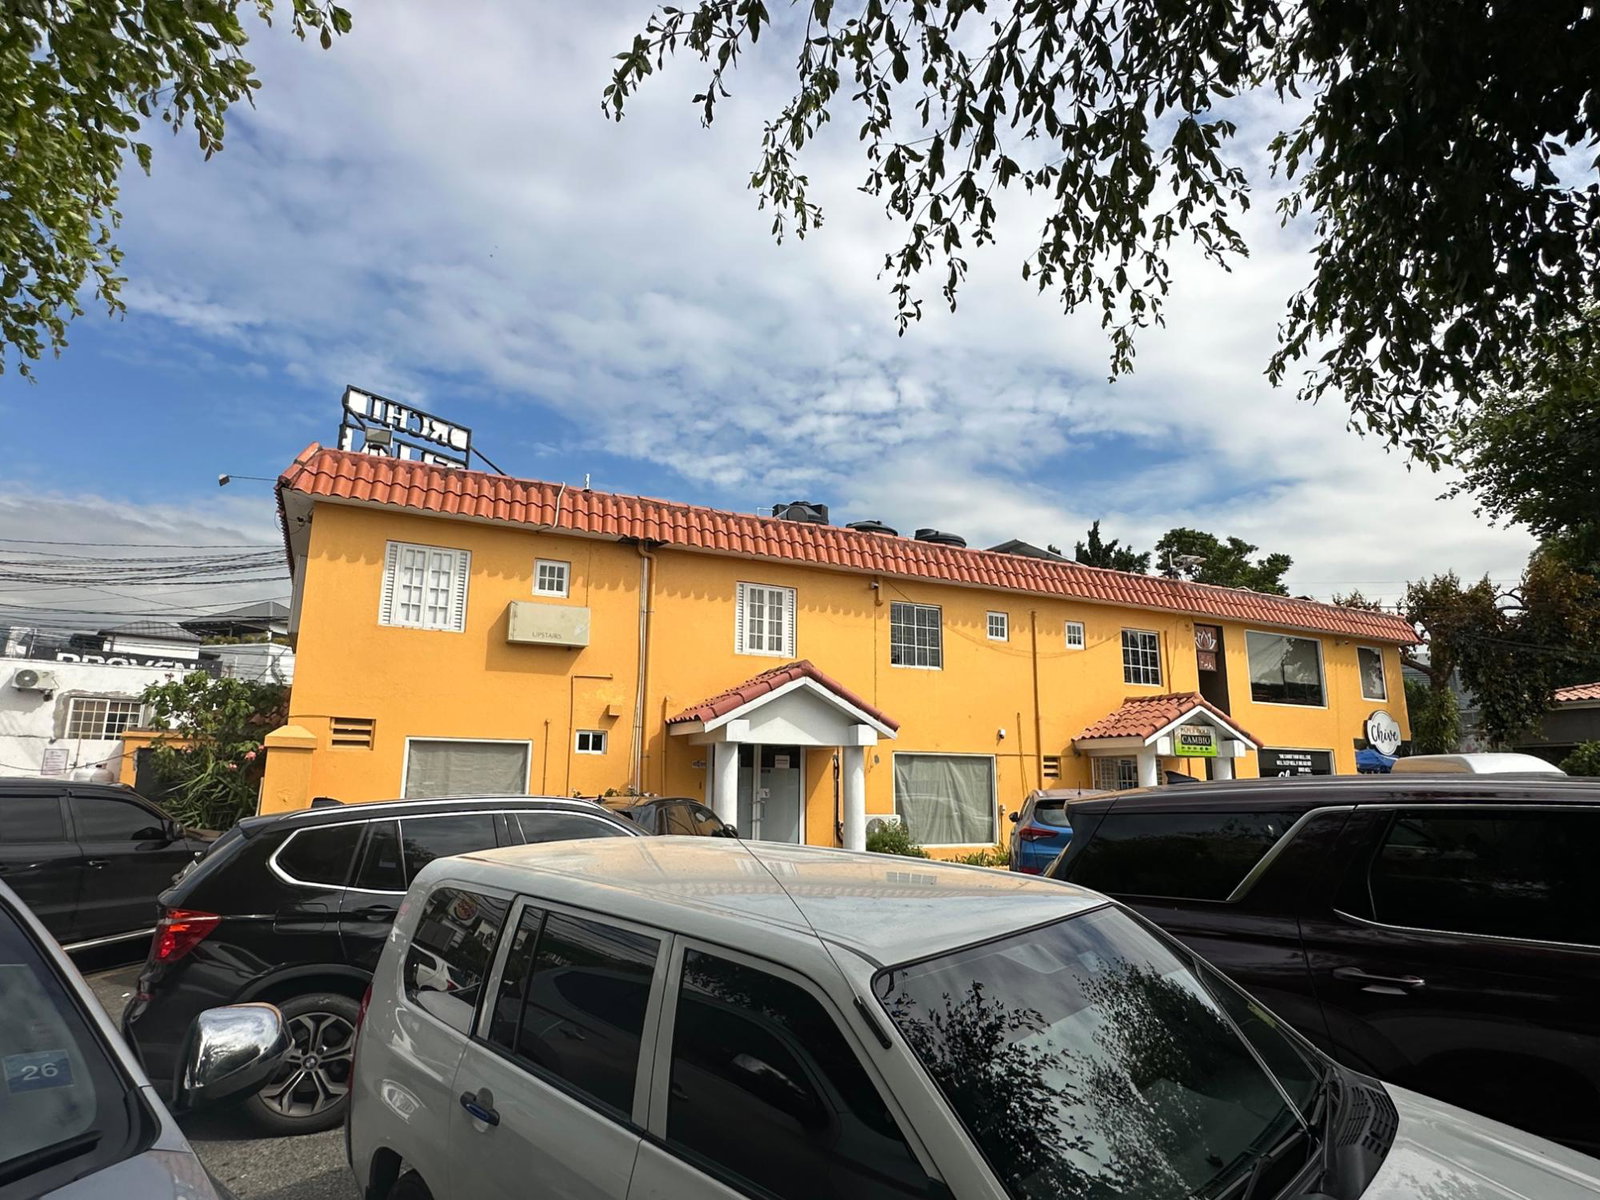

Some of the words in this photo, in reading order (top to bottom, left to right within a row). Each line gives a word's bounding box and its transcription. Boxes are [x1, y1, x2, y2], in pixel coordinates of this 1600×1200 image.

[532, 631, 562, 640] UPSTAIRS
[1371, 722, 1398, 743] Chive
[1181, 735, 1211, 745] CAMBIO
[21, 1062, 59, 1080] 26
